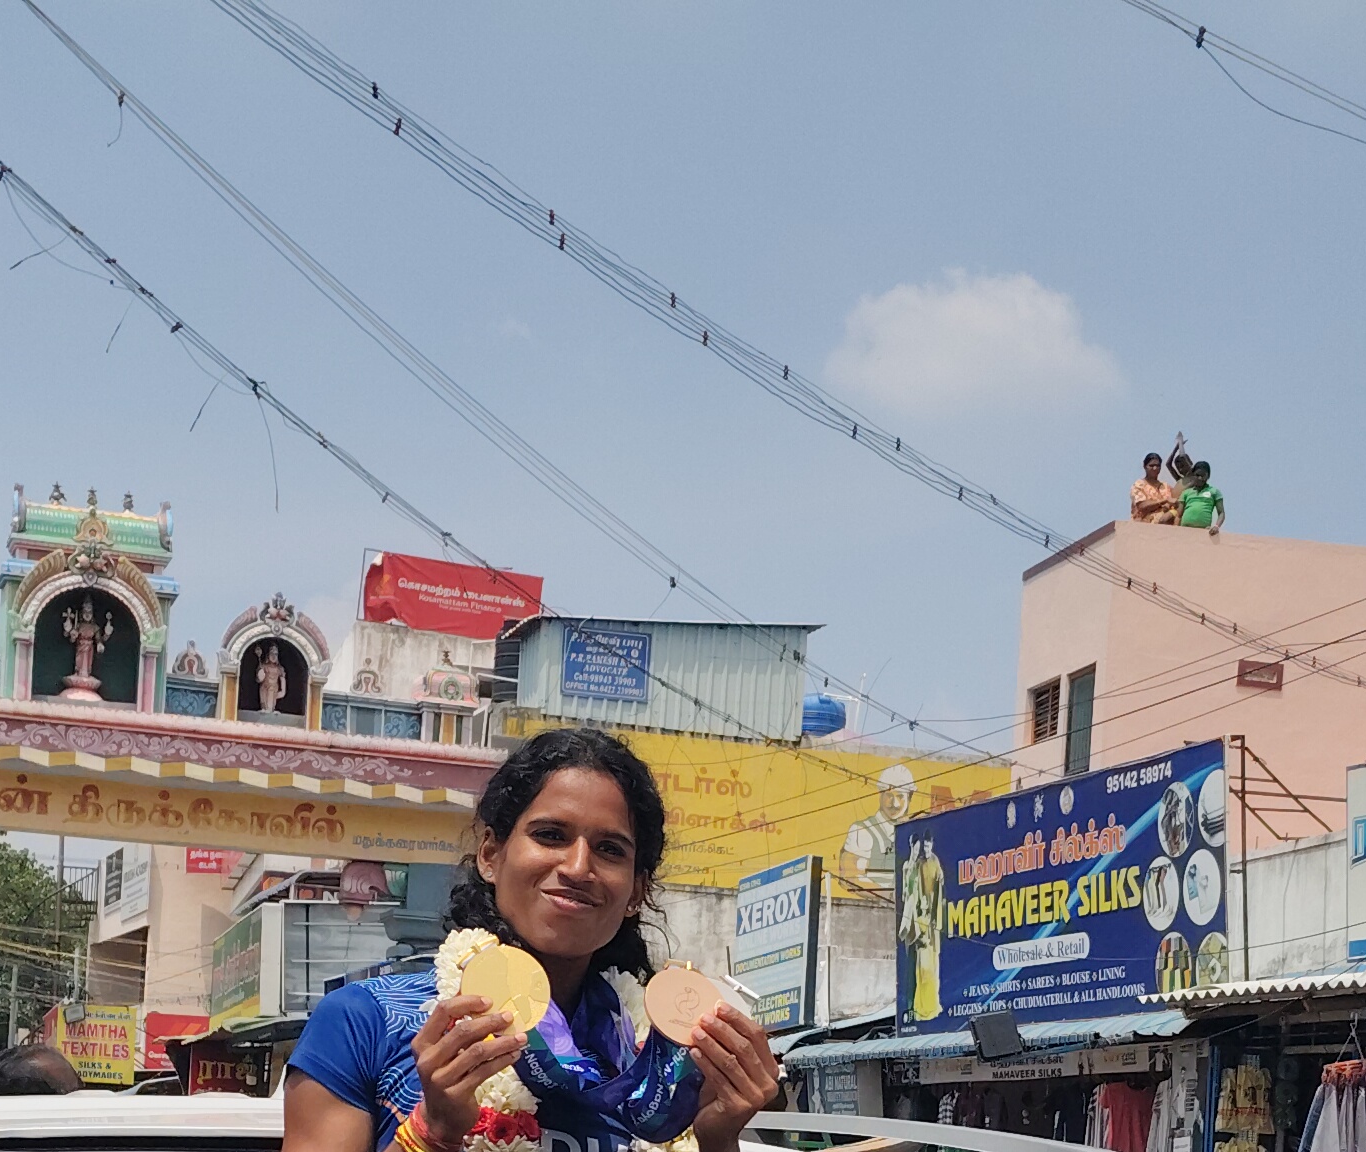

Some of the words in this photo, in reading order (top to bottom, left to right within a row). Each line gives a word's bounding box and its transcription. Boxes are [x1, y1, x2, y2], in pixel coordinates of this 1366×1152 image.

[471, 602, 502, 614] Finance
[583, 664, 629, 676] ADVOCATE
[1106, 776, 1137, 794] 95142
[1139, 761, 1173, 785] 58974
[1049, 813, 1127, 868] சில்க்ஸ்
[739, 888, 802, 936] XEROX
[948, 879, 1071, 939] MAHAVEER
[1077, 866, 1141, 917] SILKS
[997, 945, 1043, 965] Wholesale
[1045, 943, 1054, 958] &
[1057, 938, 1085, 956] Retail
[1027, 975, 1055, 989] SAREES
[1062, 971, 1091, 985] BLOUSE
[1098, 966, 1126, 981] LINING
[1013, 993, 1072, 1009] CHUDIMATERIAL
[1080, 990, 1096, 1001] ALL
[1097, 982, 1146, 1000] HANDLOOMS
[66, 1022, 127, 1040] MAMTHA
[61, 1040, 130, 1059] TEXTILES
[78, 1061, 102, 1069] SILKS
[992, 1070, 1036, 1079] MAHAVEER
[1038, 1067, 1062, 1078] SILKS
